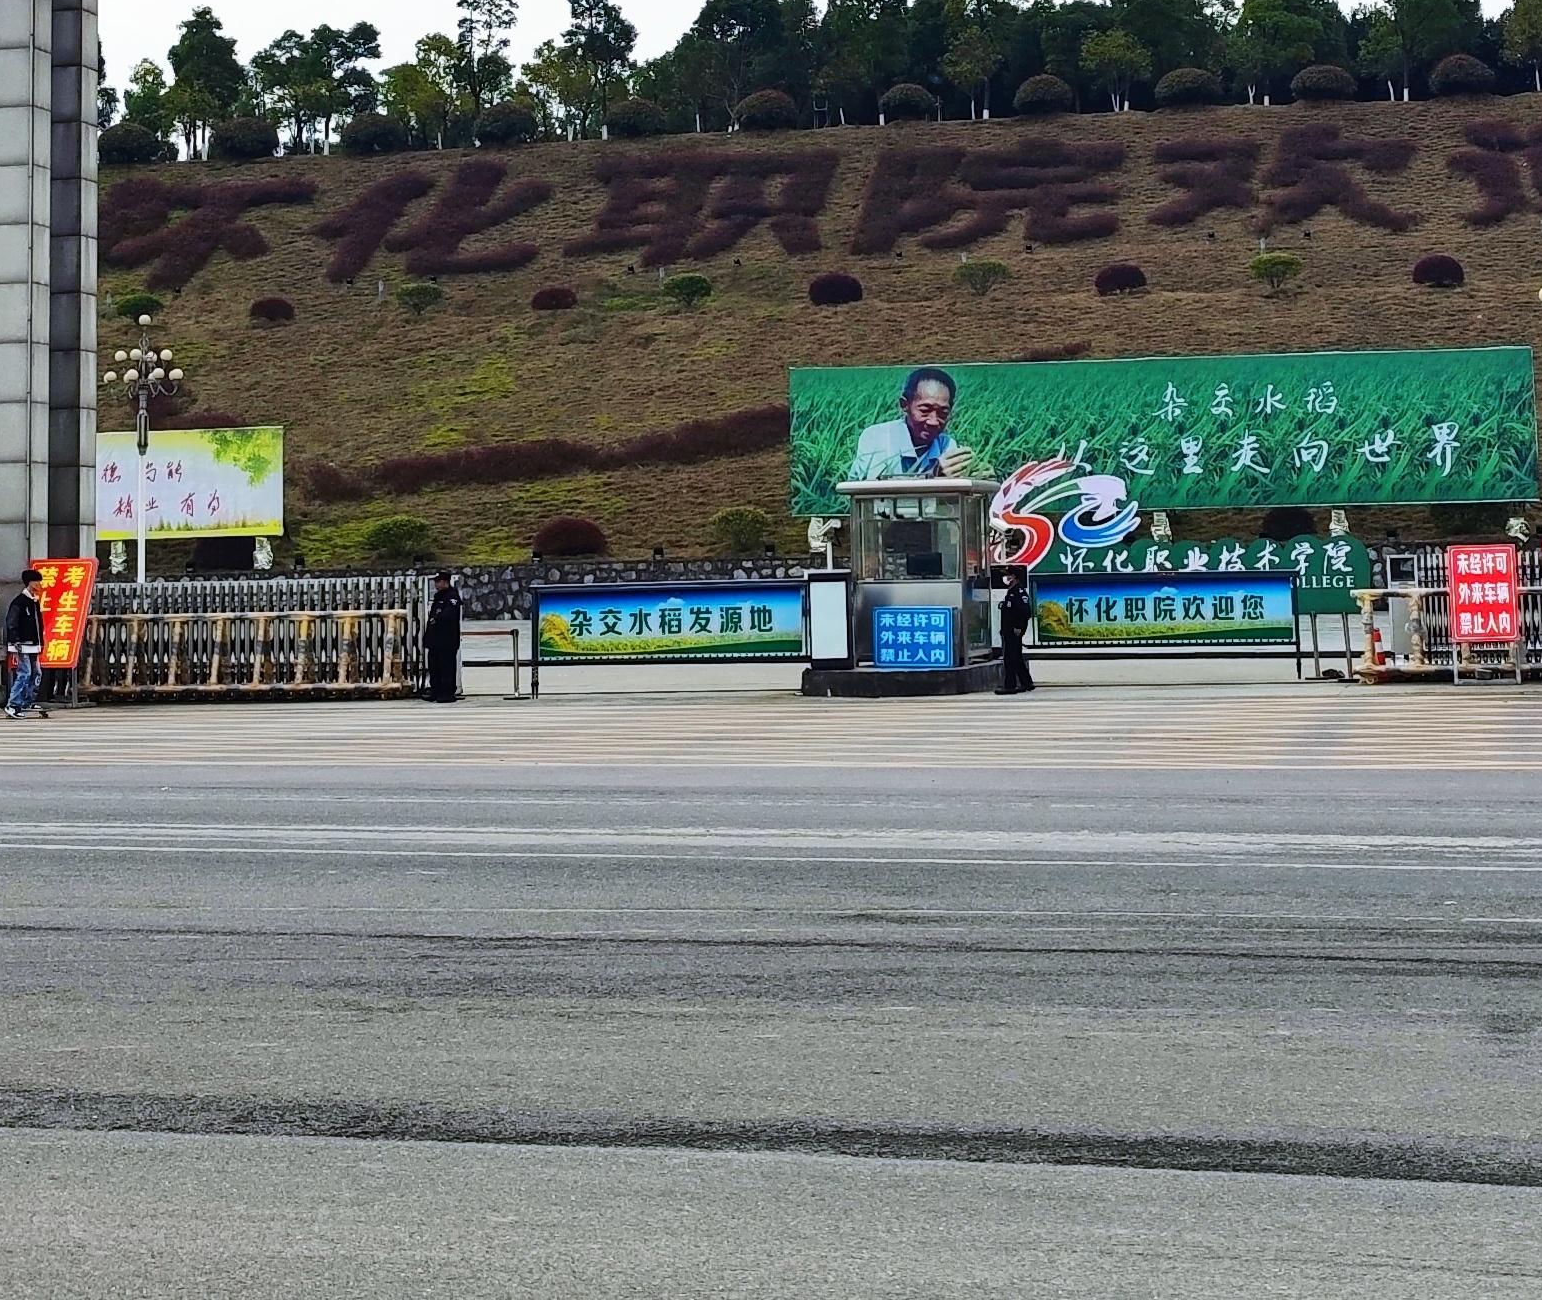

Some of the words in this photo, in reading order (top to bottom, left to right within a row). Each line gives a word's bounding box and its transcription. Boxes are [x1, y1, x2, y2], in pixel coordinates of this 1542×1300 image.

[1153, 380, 1338, 422] 杂交水稻
[1055, 421, 1464, 477] 从这里走向世界
[1059, 540, 1355, 575] 怀化职业技术学院
[1456, 551, 1508, 576] 未经许可
[1065, 594, 1266, 624] 怀化职院欢迎您
[1458, 581, 1511, 605] 外来车辆
[46, 566, 86, 661] 考生车辆
[569, 603, 776, 638] 杂交水稻发源地
[879, 613, 946, 628] 未经许可
[879, 631, 947, 645] 外来车辆
